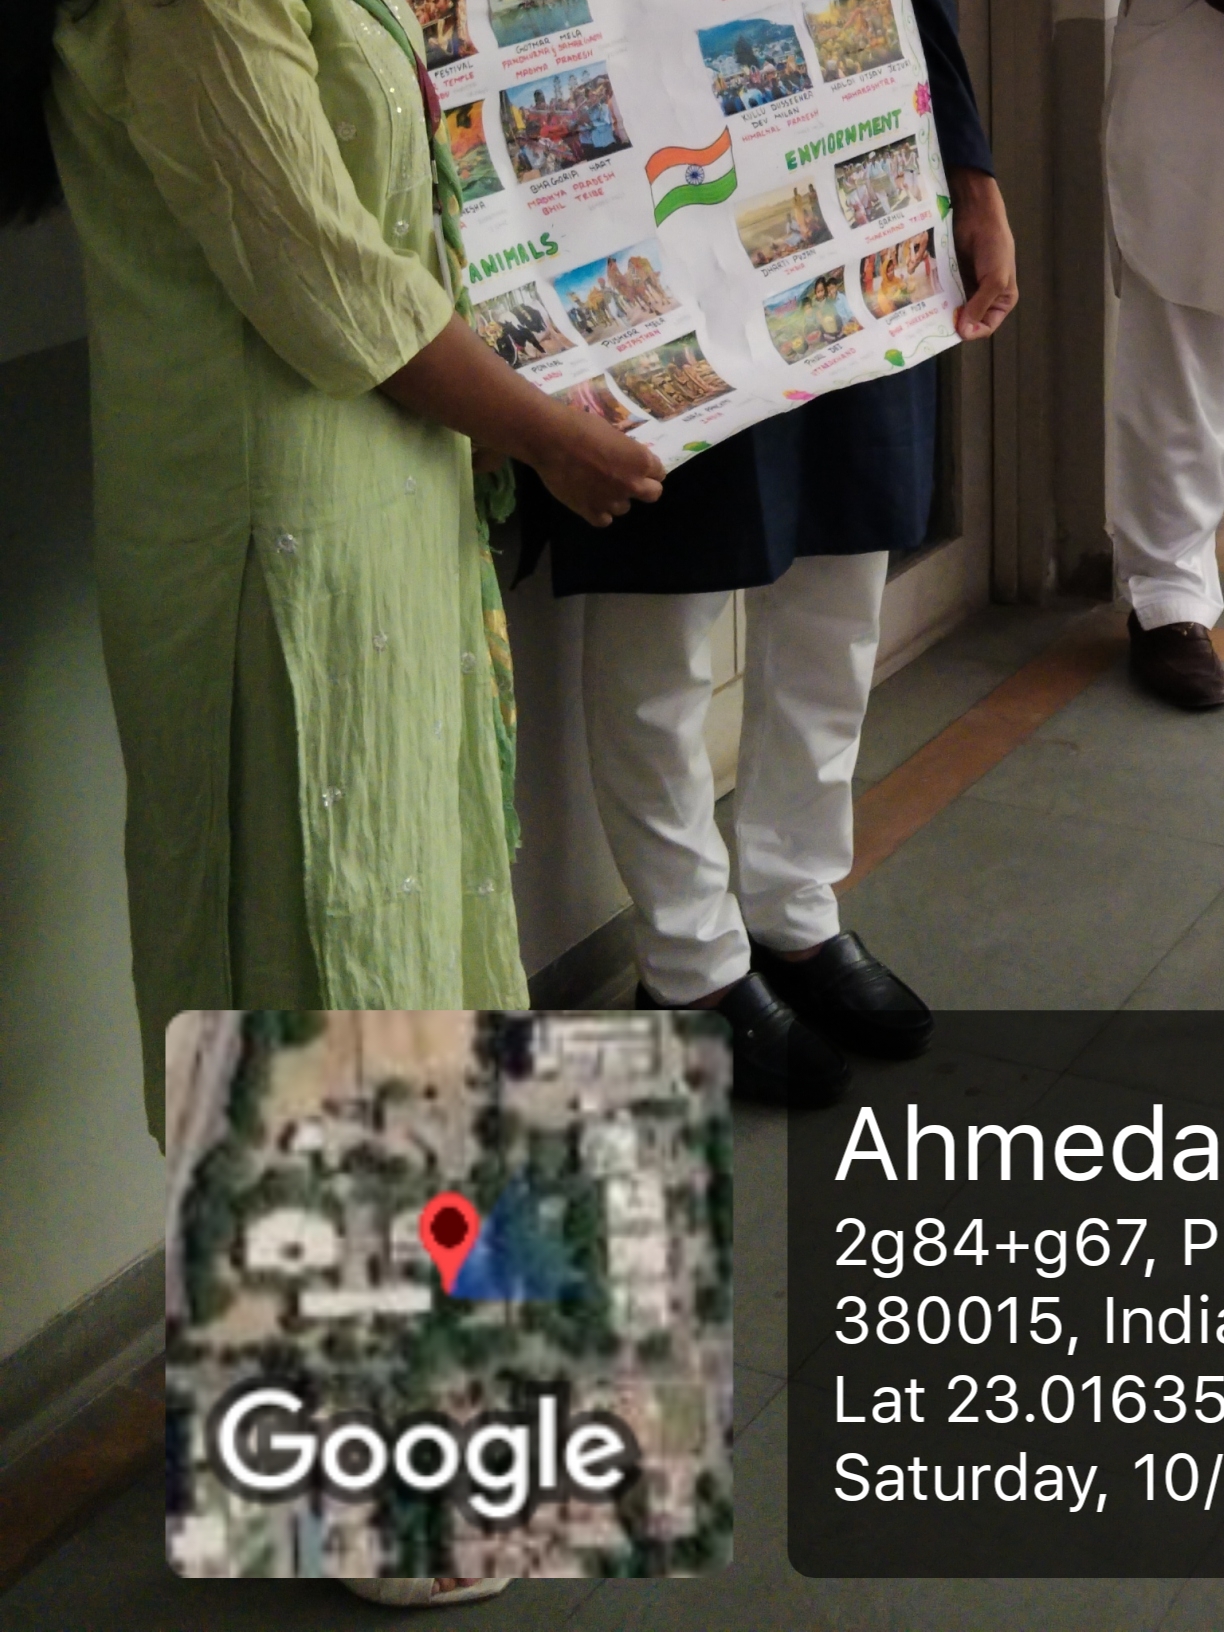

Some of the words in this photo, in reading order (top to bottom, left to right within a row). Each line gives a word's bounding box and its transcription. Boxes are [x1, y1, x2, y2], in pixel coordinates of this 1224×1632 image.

[560, 30, 582, 41] MELA
[555, 50, 594, 66] PRADESH
[434, 60, 474, 80] FESTIVAL
[751, 118, 768, 129] DEV
[572, 171, 616, 191] PRADESH
[468, 232, 559, 285] ANIMALS
